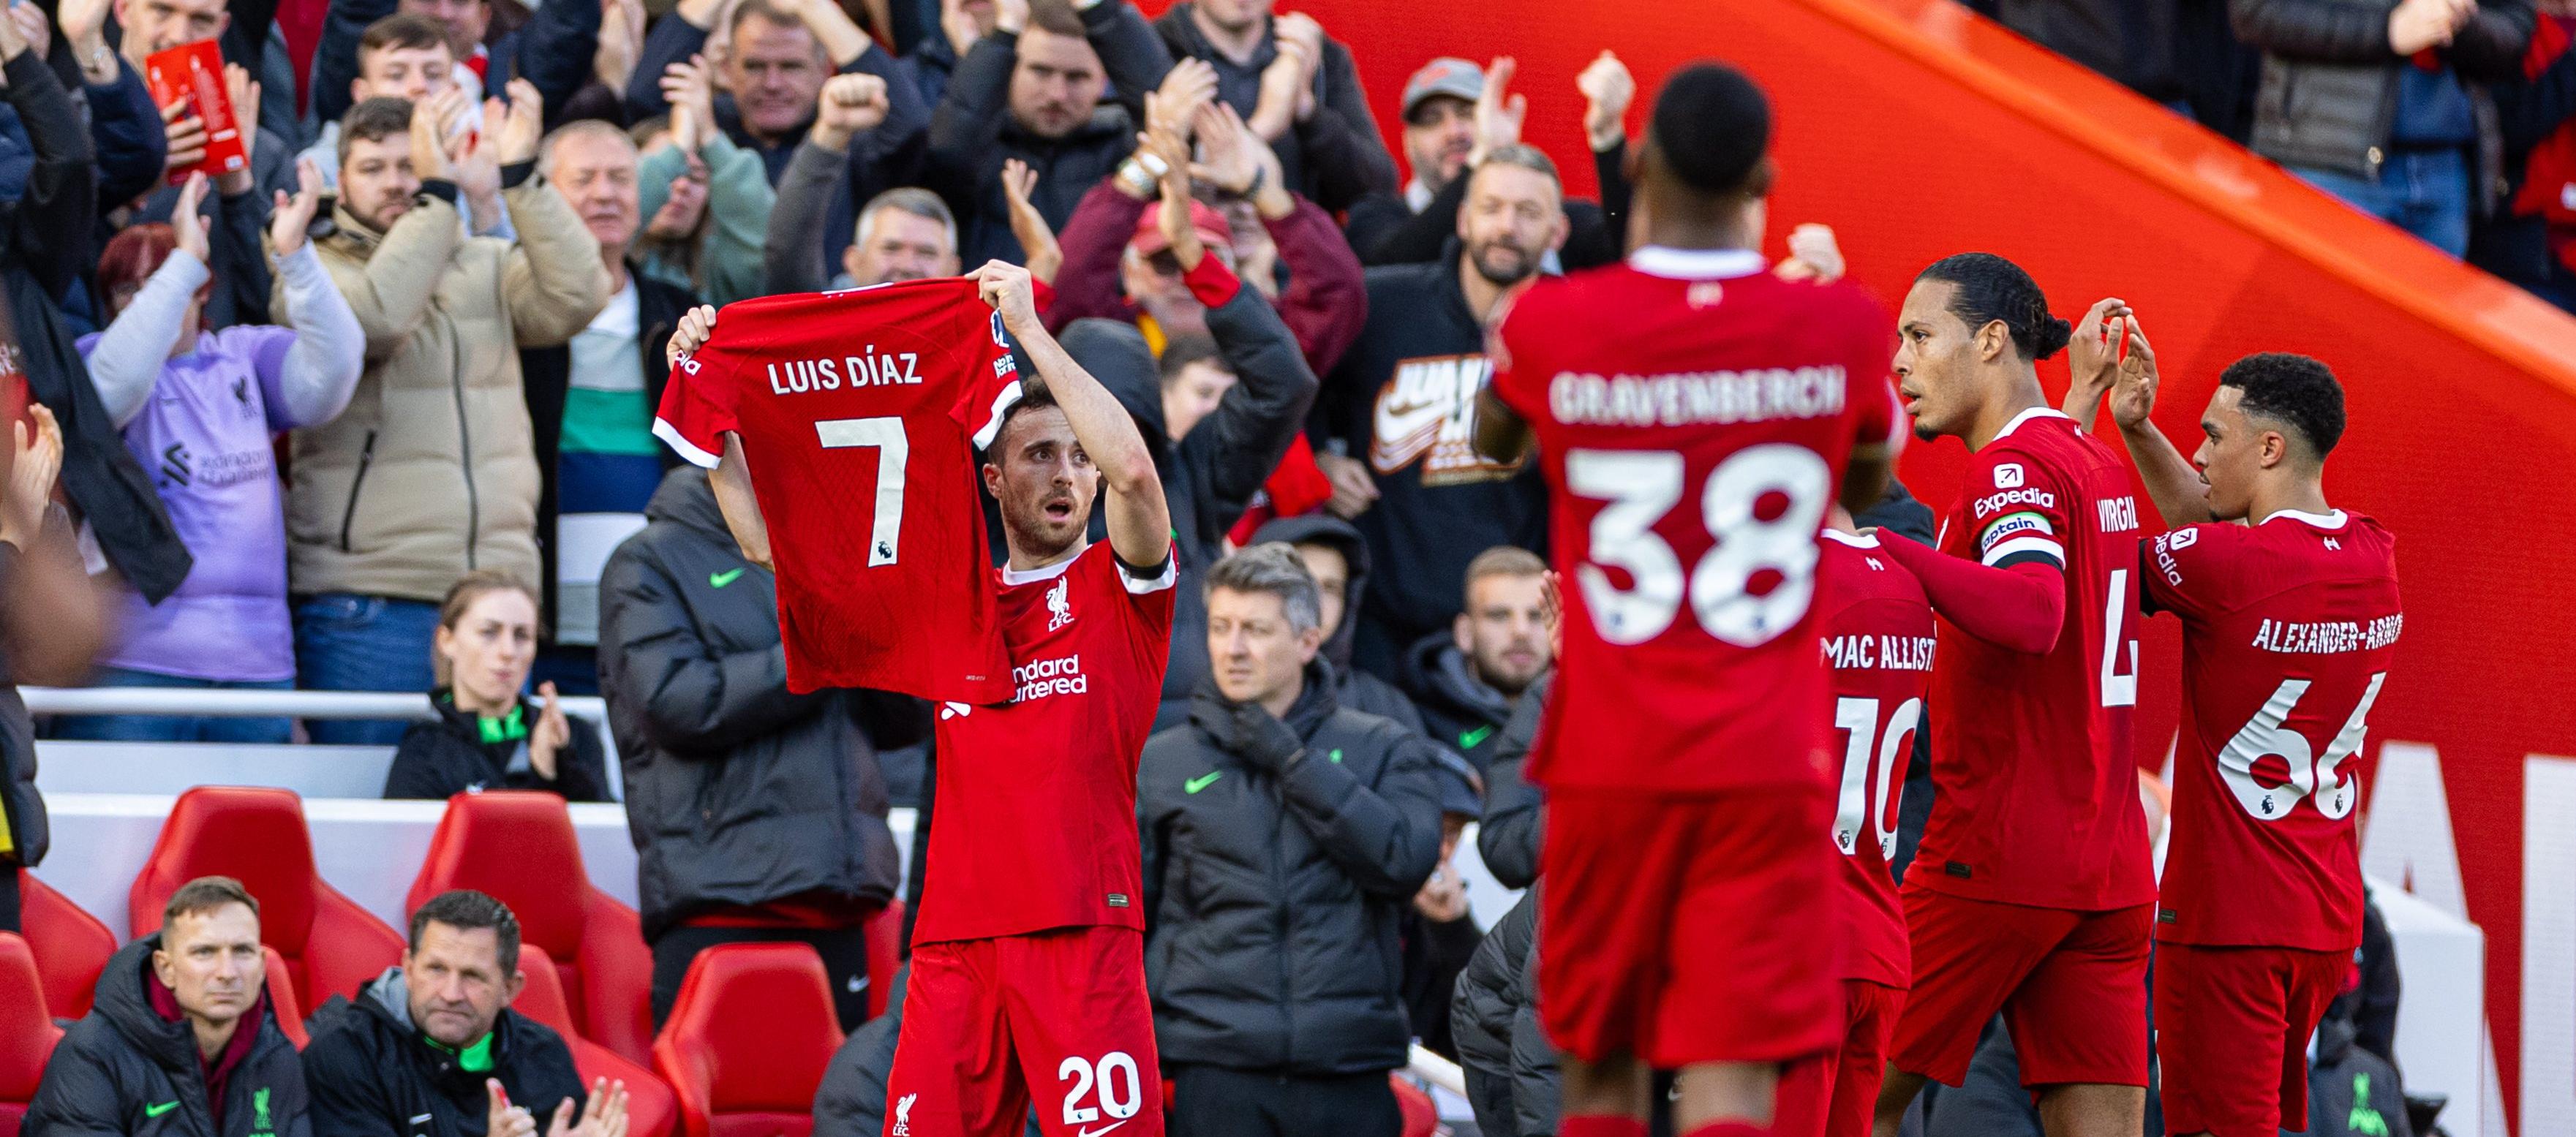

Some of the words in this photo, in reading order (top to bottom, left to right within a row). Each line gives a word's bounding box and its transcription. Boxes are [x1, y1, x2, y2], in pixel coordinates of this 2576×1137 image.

[767, 358, 840, 395] LUIS
[845, 344, 922, 388] DÍAZ
[1549, 366, 1846, 426] GRAVENBERCH
[814, 416, 909, 567] 7
[1975, 488, 2055, 519] Expedia
[2097, 496, 2139, 533] VIRGIL
[1564, 442, 1833, 648] 38
[1983, 516, 2036, 550] aptain
[2154, 531, 2183, 586] pedia
[1820, 634, 1875, 668] MAC
[1880, 635, 1937, 672] ALLIST
[2101, 568, 2139, 708] 4
[2251, 612, 2403, 654] ALEXANDER-ARNO
[1012, 654, 1079, 684] ndard
[2218, 671, 2387, 821] 66
[1831, 697, 1921, 862] 10
[1058, 1051, 1142, 1125] 20
